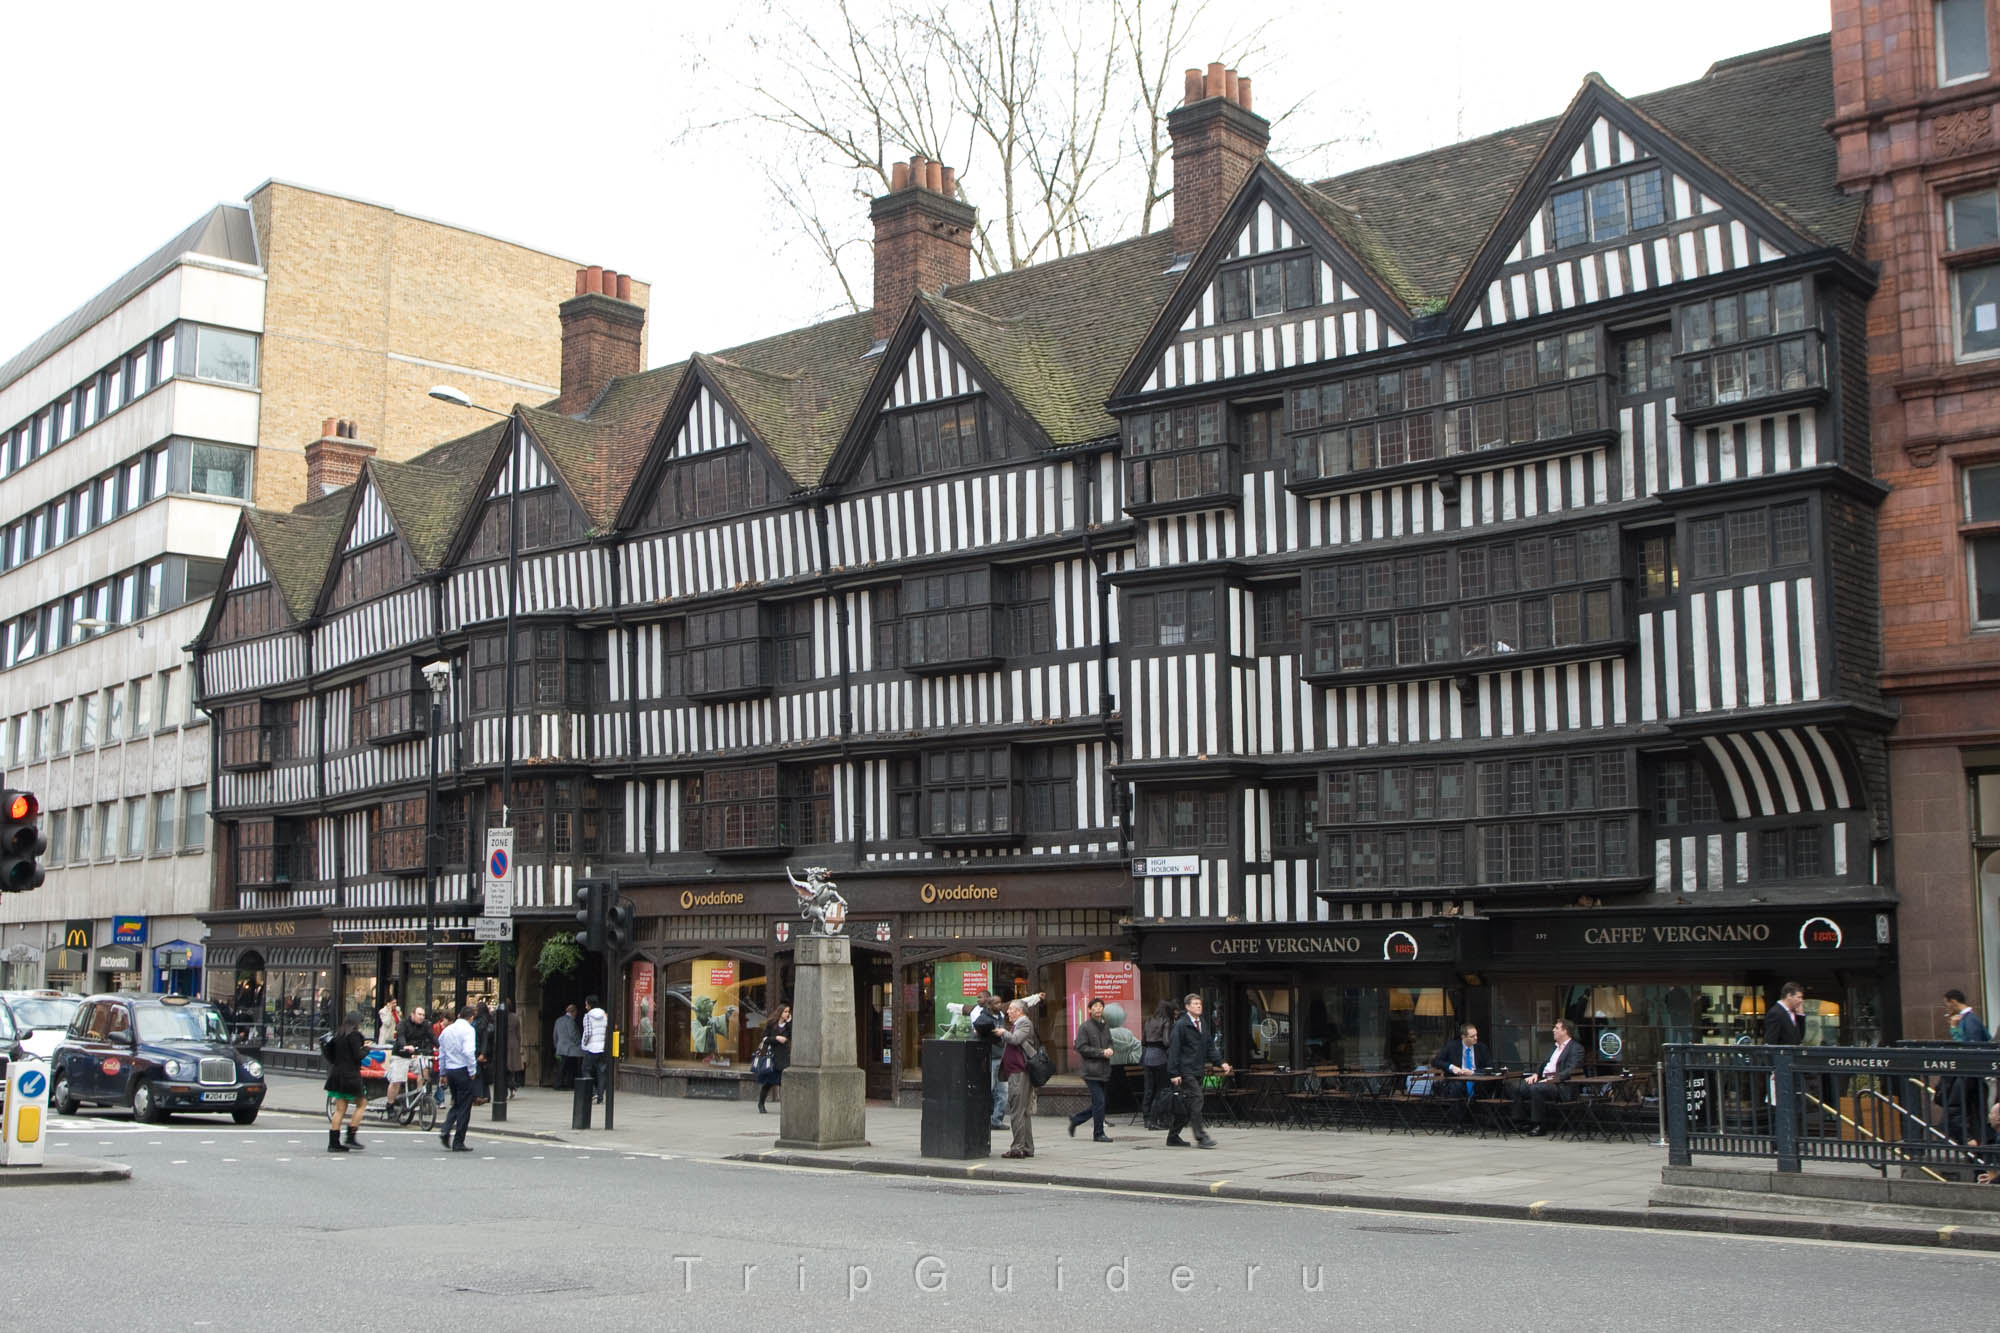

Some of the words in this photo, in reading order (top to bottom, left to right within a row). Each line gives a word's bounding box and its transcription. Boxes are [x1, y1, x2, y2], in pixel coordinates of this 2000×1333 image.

[693, 890, 744, 905] vodafone
[937, 884, 998, 900] vodafone
[238, 924, 264, 936] LIPMAN
[266, 924, 272, 936] &
[274, 922, 296, 936] SONS
[1583, 927, 1646, 944] CAFFE'
[1652, 924, 1769, 942] VERGNANO
[363, 930, 417, 944] SANFORD
[1210, 939, 1261, 954] CAFFE'
[1266, 937, 1360, 952] VERGNANO
[1828, 1058, 1889, 1068] CHANCERY
[1924, 1061, 1956, 1069] LANE
